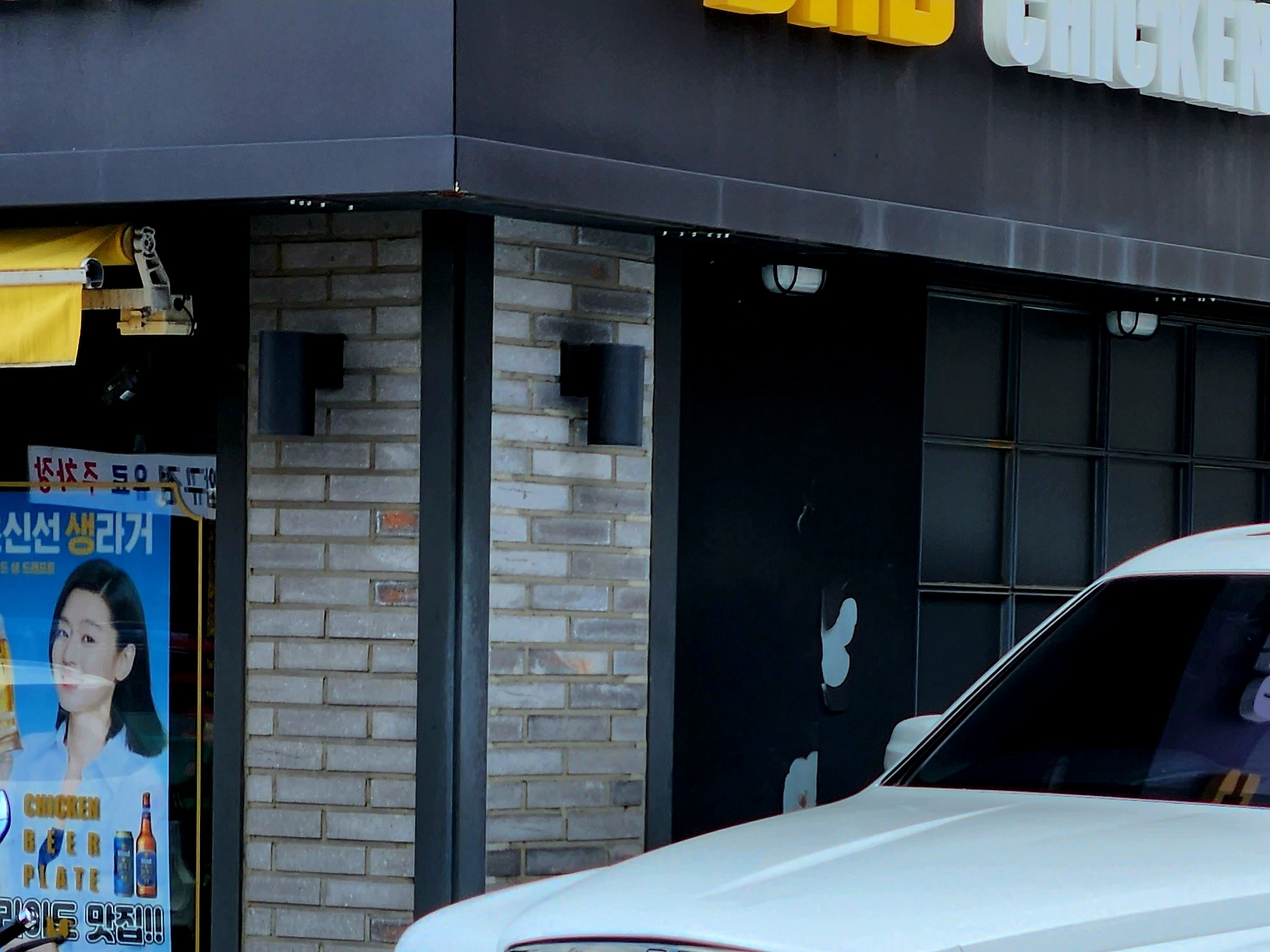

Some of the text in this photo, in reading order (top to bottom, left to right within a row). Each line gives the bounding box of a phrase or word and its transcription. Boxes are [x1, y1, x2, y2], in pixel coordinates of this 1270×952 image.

[0, 512, 153, 556] 신선 생라거
[23, 793, 101, 821] CHICKEN
[23, 828, 101, 857] BEER
[23, 863, 100, 893] PLATE
[85, 901, 165, 947] 맛집!!
